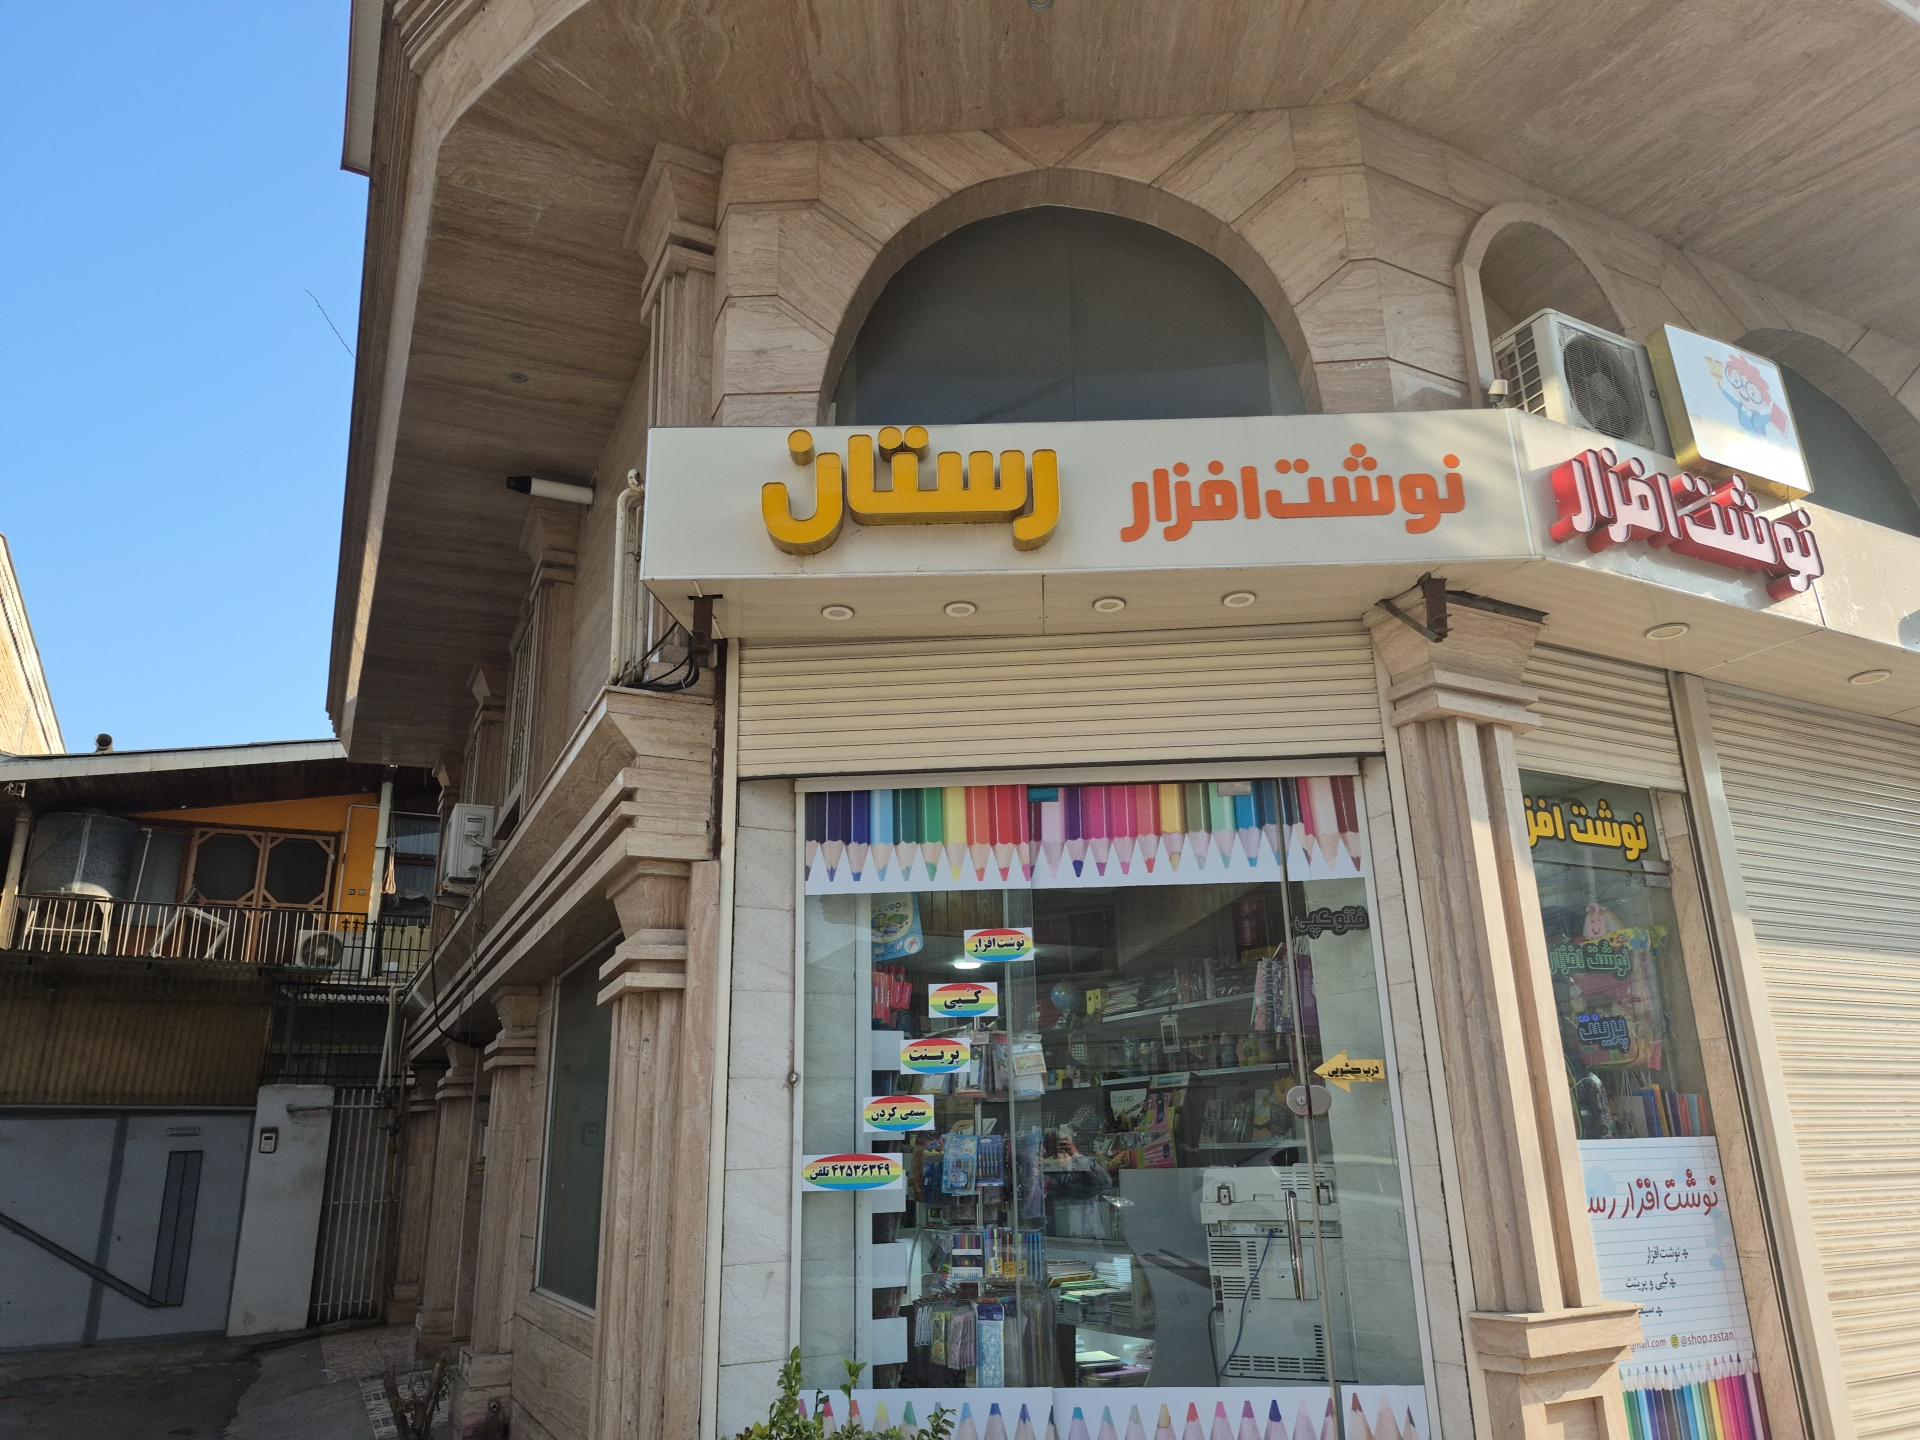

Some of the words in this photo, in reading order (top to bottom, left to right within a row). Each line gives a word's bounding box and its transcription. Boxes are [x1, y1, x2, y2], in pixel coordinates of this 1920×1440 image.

[761, 425, 1060, 553] رستان
[1578, 1014, 1629, 1054] پرینت
[909, 1048, 960, 1065] پرینت
[871, 1106, 898, 1121] کردن
[900, 1109, 927, 1121] سیمی
[809, 1166, 830, 1180] تلفن
